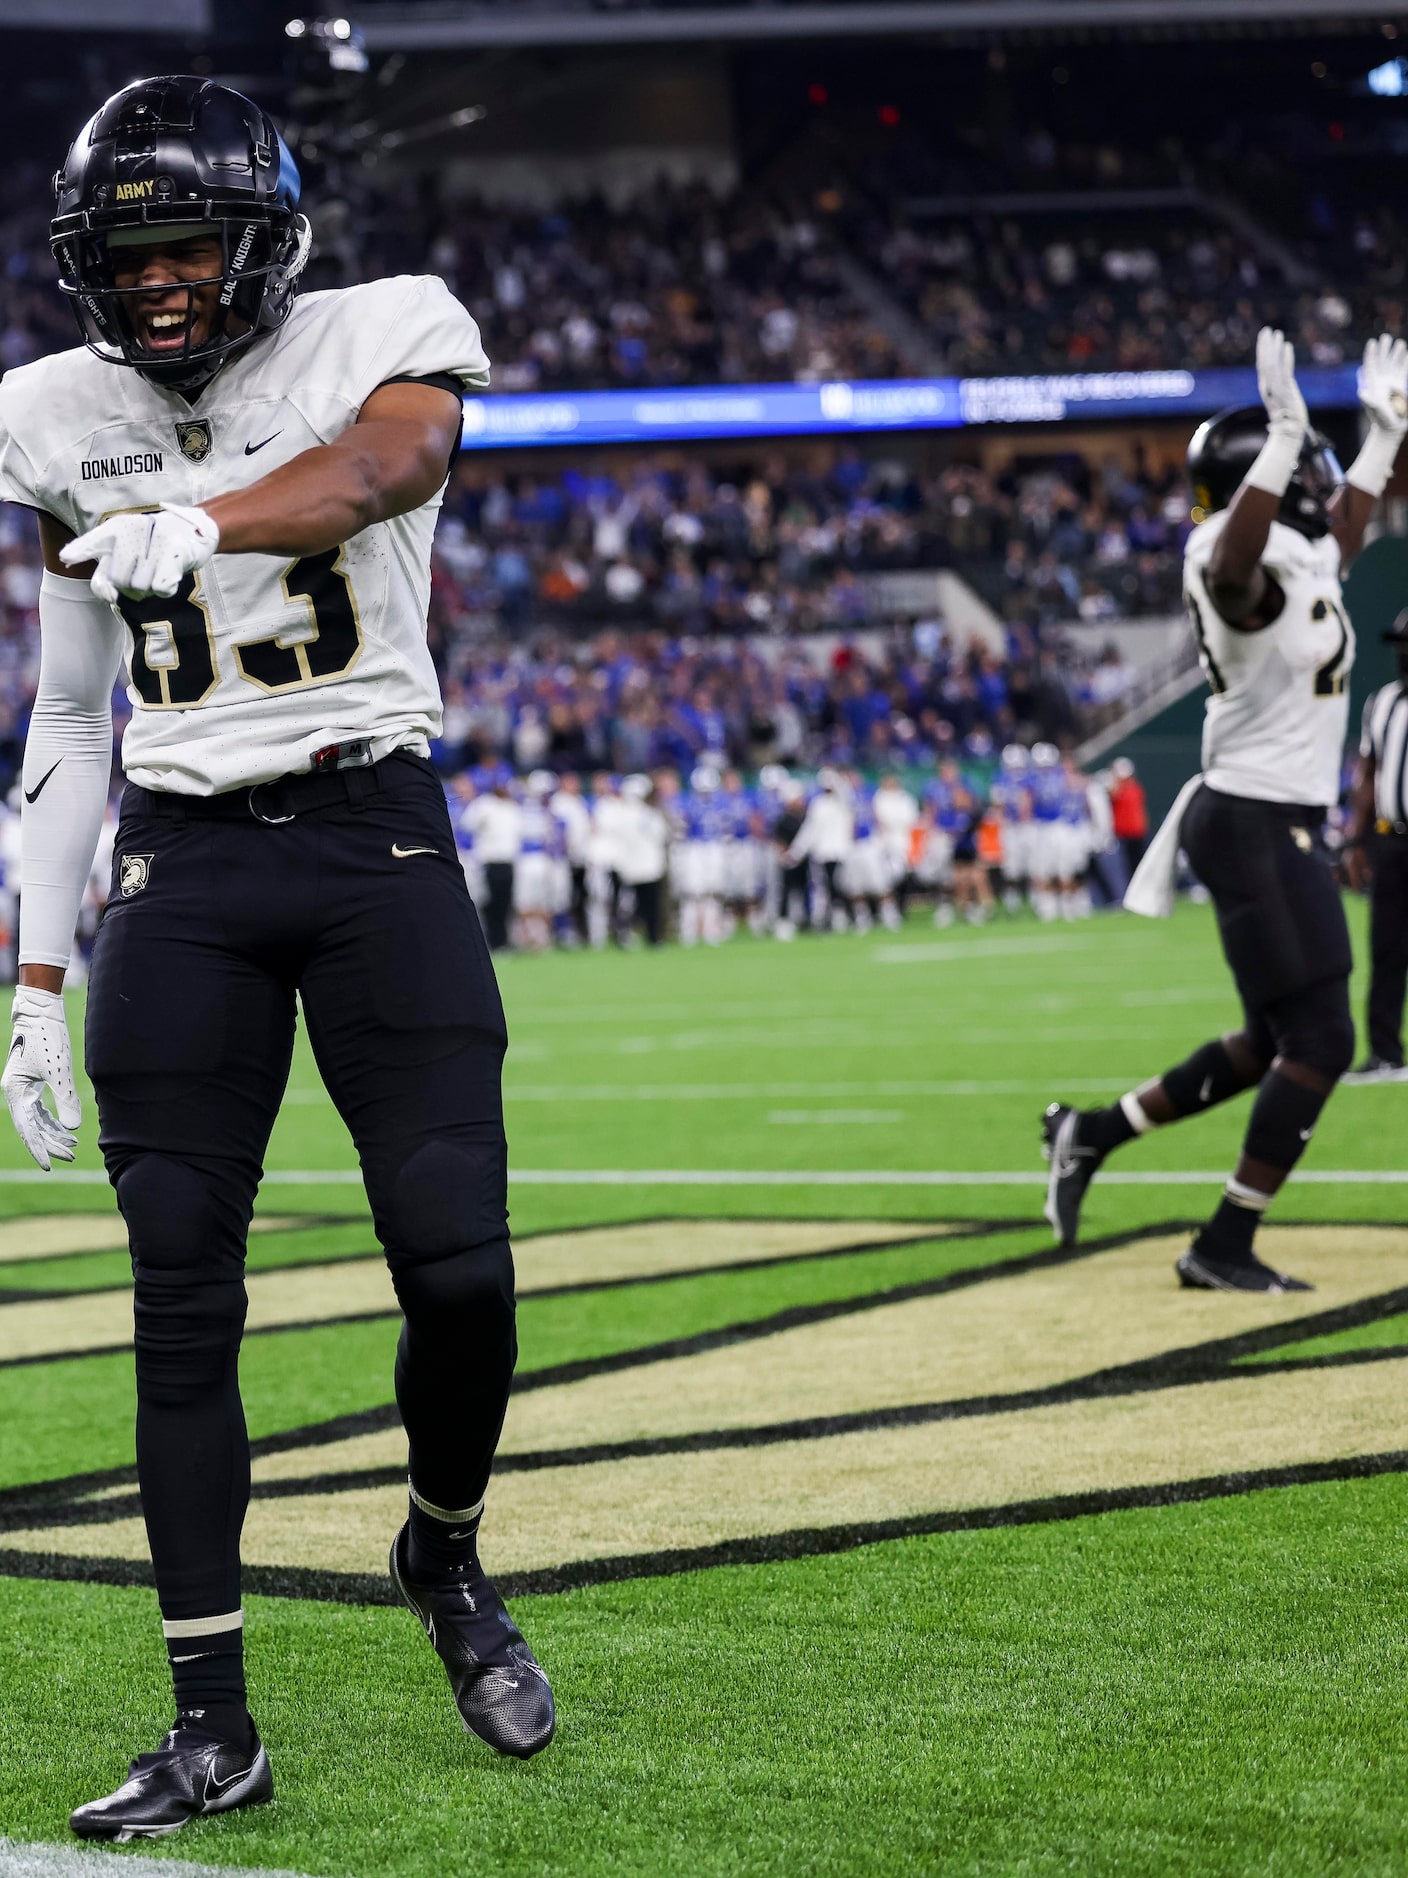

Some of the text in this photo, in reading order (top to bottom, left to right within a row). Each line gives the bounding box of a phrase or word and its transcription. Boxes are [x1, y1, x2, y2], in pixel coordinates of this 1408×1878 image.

[115, 179, 154, 201] ARMY
[81, 452, 163, 481] DONALDSON
[97, 502, 365, 711] 83
[348, 743, 362, 754] M
